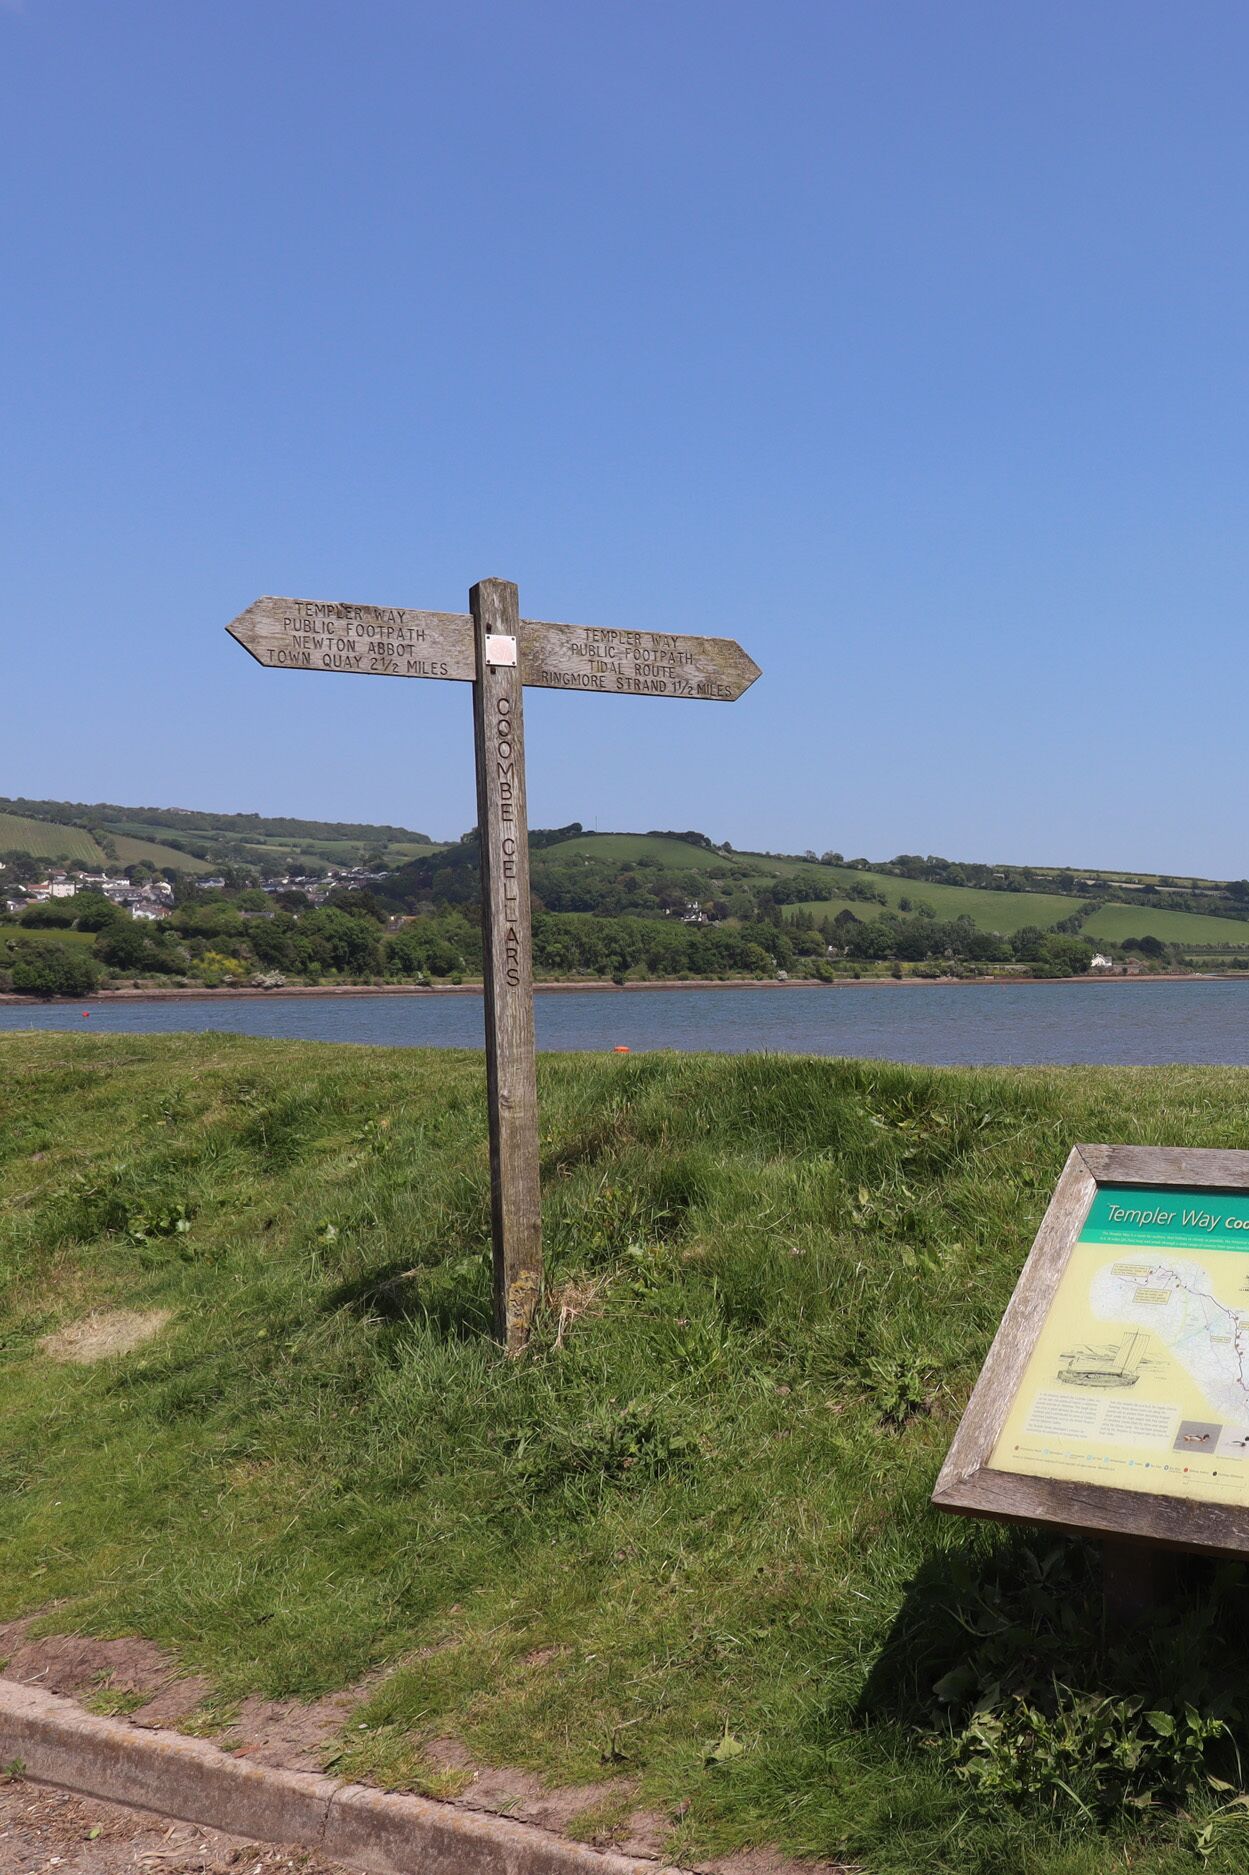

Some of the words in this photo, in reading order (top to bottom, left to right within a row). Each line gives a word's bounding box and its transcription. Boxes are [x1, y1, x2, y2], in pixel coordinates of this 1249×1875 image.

[295, 602, 363, 621] TEMPLER
[374, 609, 407, 624] WAY
[283, 617, 336, 635] PUBLIC
[346, 622, 426, 642] FOOTPATH
[583, 628, 641, 646] TEMPLER
[651, 633, 679, 649] WAY
[292, 635, 356, 653] NEWTON
[367, 642, 416, 657] ABBOT
[571, 643, 616, 659] PUBLIC
[625, 648, 694, 666] FOOTPATH
[267, 649, 312, 665] TOWN
[323, 653, 362, 669] QUAY
[407, 660, 449, 676] MILES
[588, 659, 625, 675] TIDAL
[635, 663, 676, 679] ROUTE
[541, 671, 606, 689] RINGMORE
[616, 677, 667, 694] STRAND
[697, 682, 732, 698] MILES
[497, 698, 514, 821] COOMBE
[502, 838, 520, 986] CELLARS
[1108, 1204, 1176, 1227] Templer
[1181, 1209, 1222, 1232] Way
